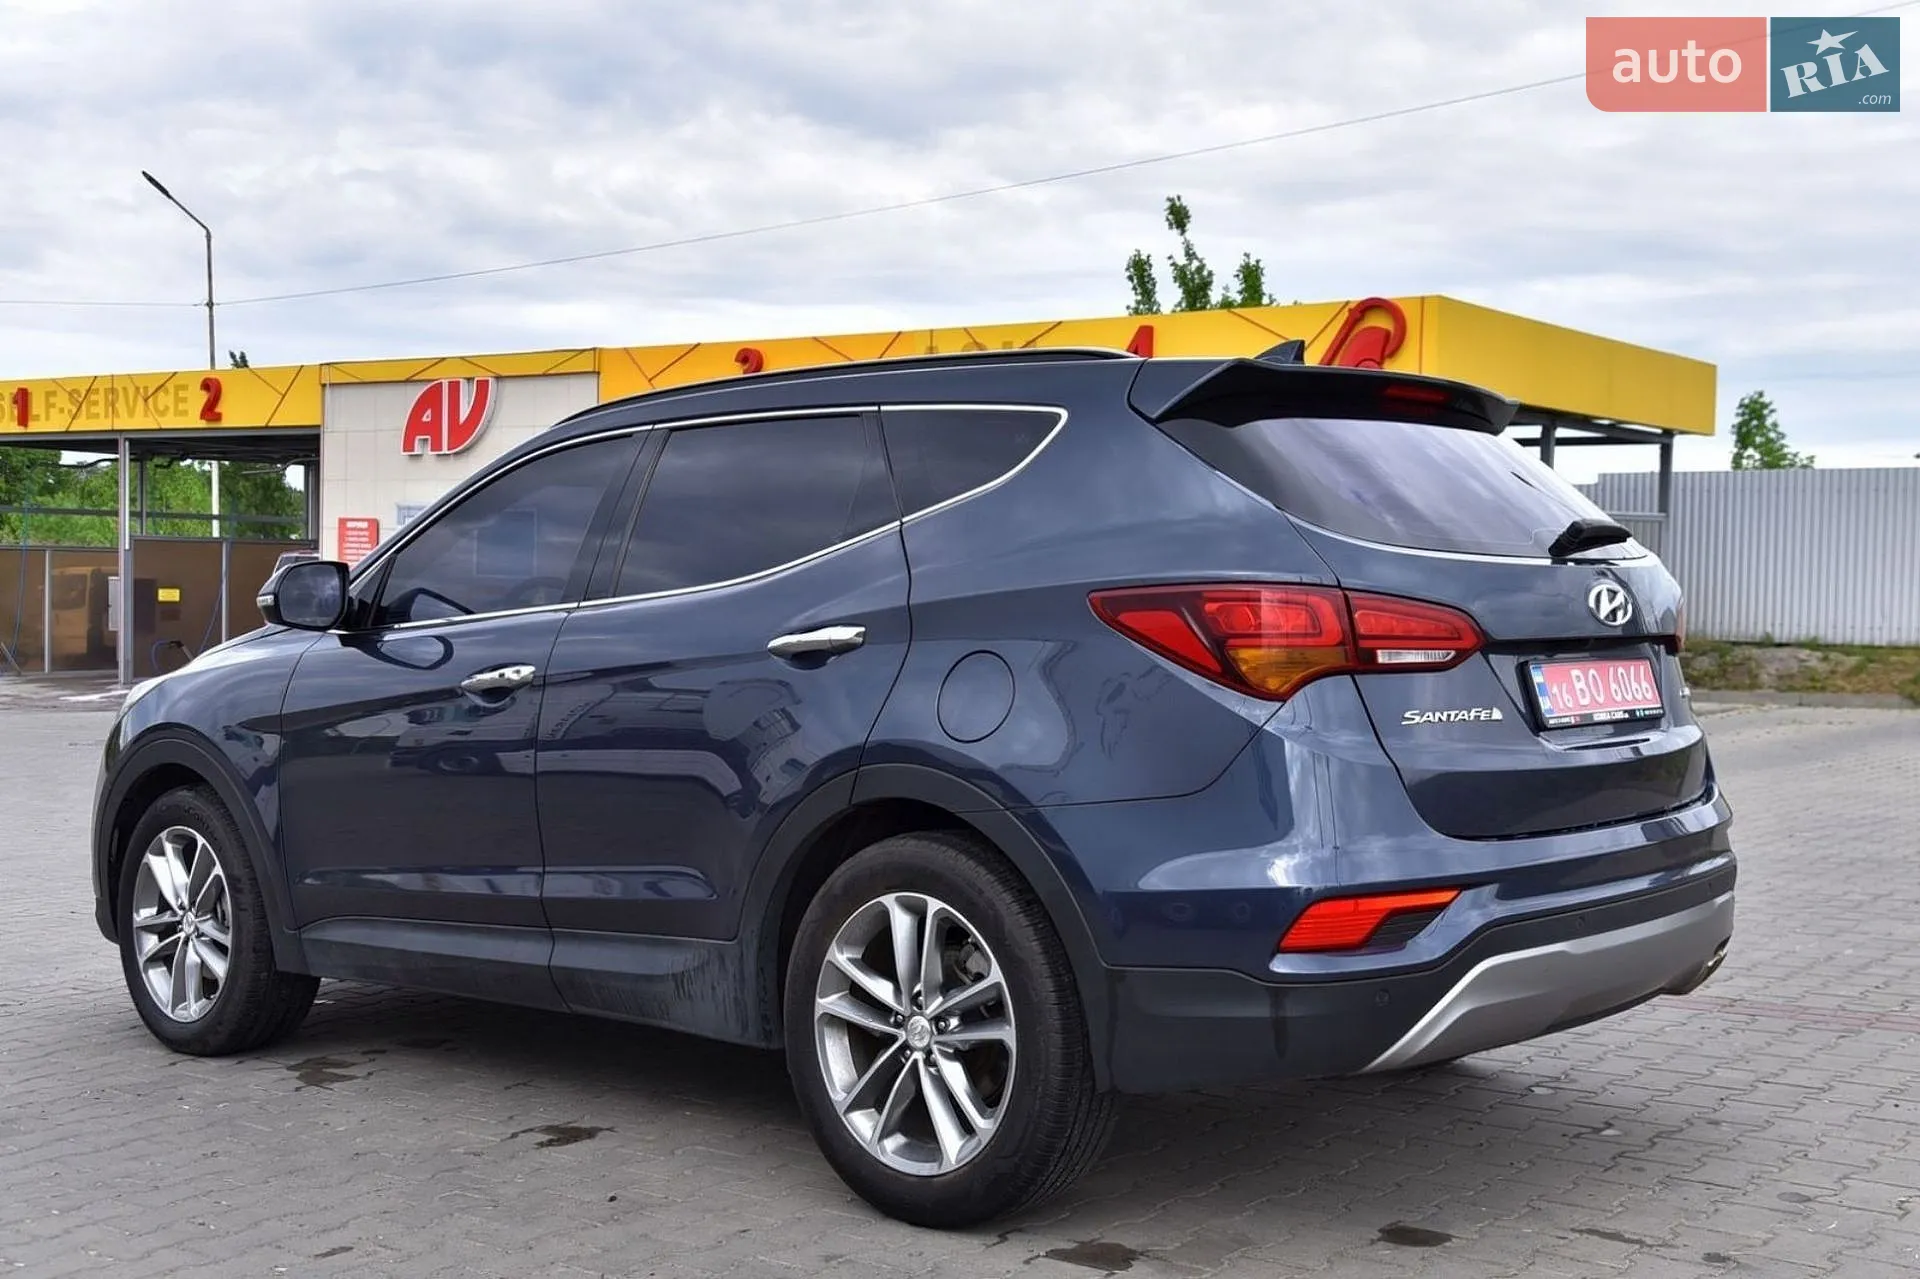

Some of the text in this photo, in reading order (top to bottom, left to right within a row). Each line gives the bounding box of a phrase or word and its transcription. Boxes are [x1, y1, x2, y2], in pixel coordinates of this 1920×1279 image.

[12, 387, 28, 427] 1
[200, 377, 222, 422] 2
[401, 377, 491, 455] AV
[1552, 665, 1654, 709] 16 BO 6066
